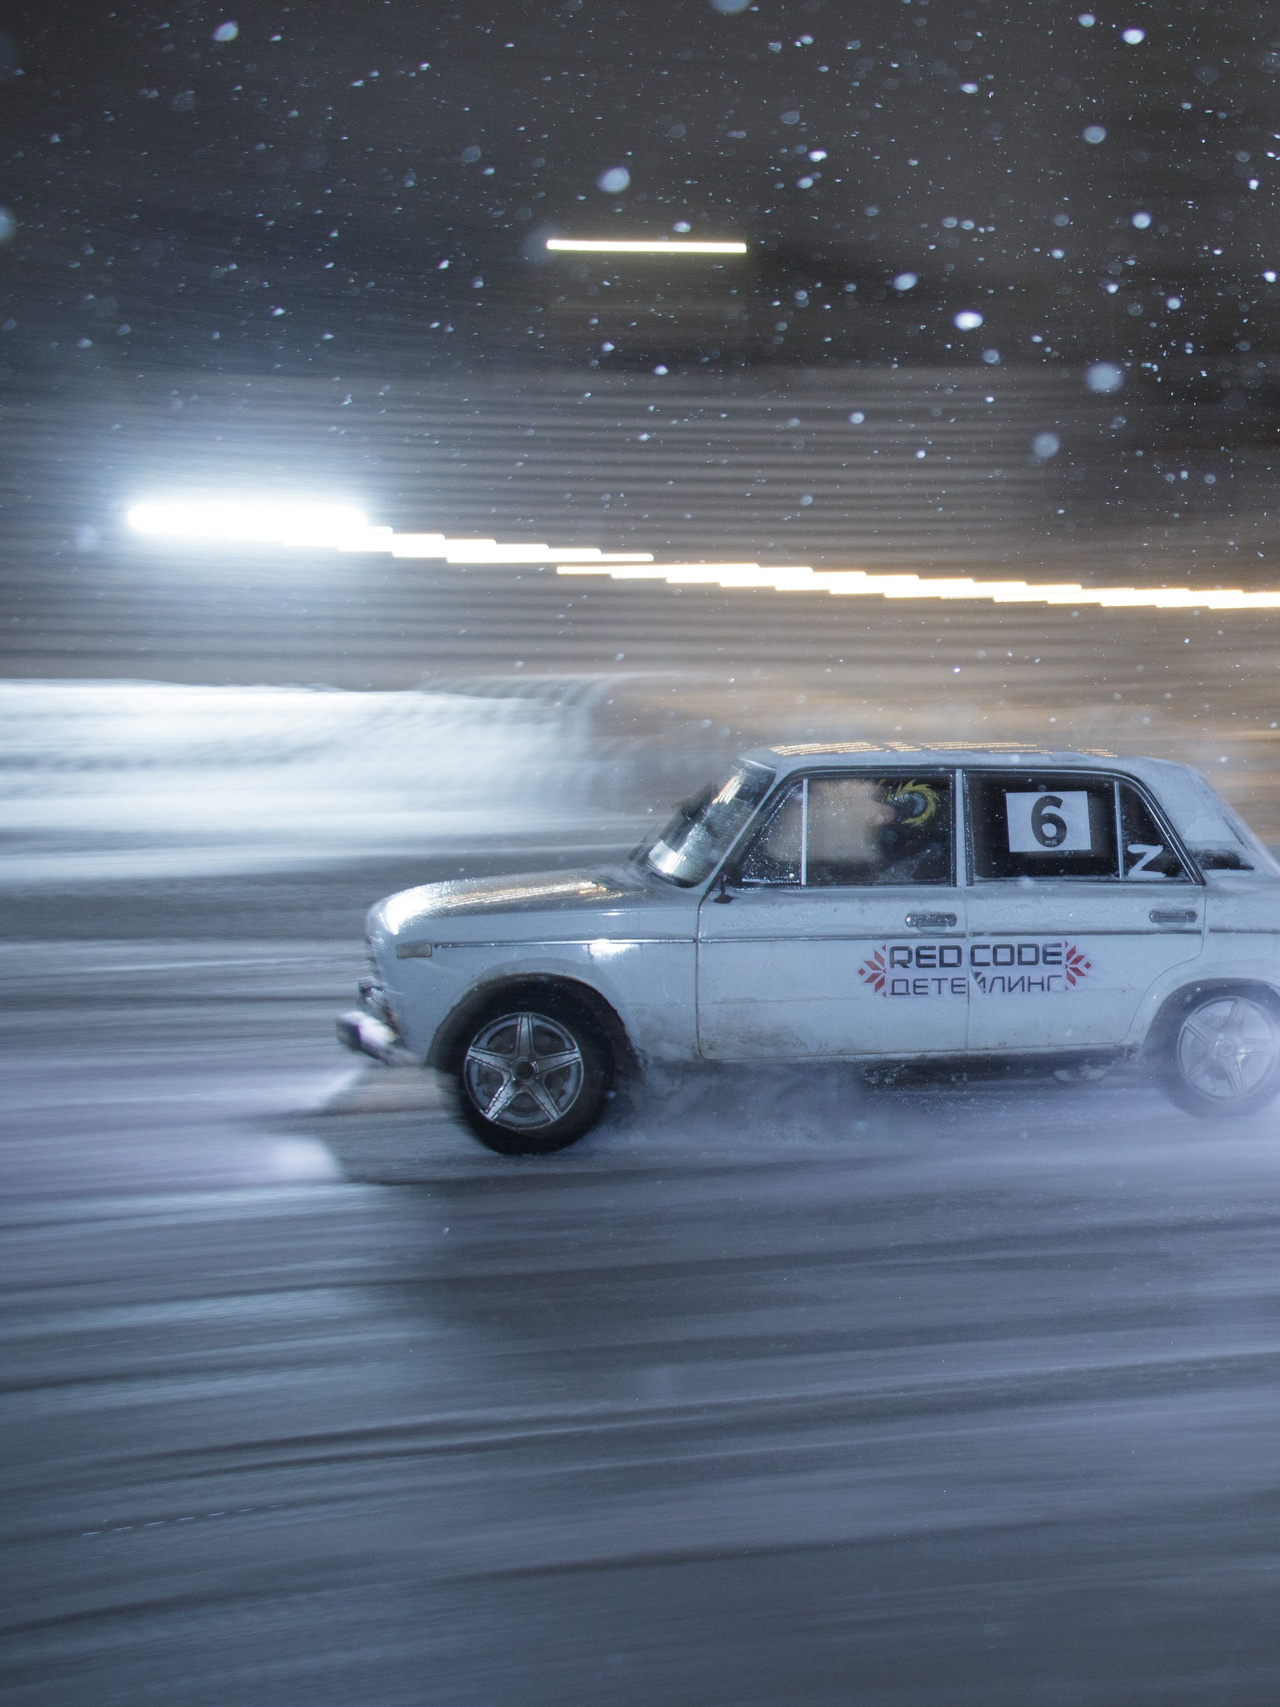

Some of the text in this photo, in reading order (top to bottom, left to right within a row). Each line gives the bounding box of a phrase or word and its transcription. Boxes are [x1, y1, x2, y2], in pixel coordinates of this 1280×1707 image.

[1031, 795, 1067, 847] 6
[1127, 844, 1166, 878] Z
[889, 943, 1063, 969] RED CODE
